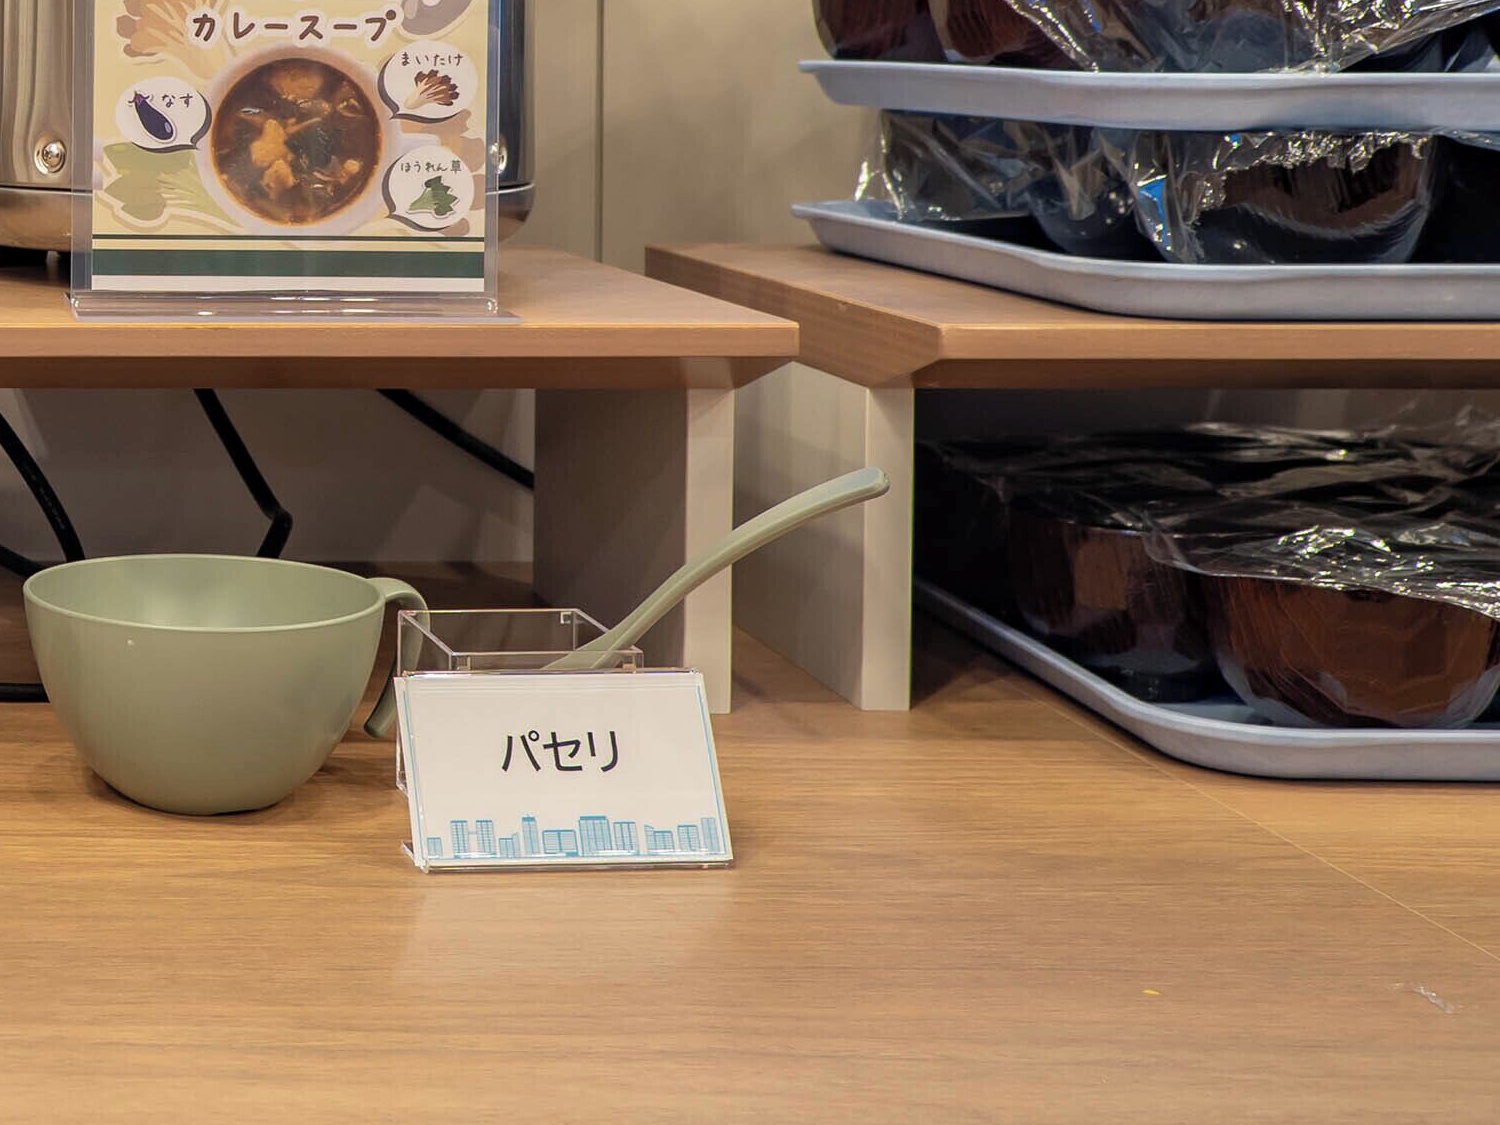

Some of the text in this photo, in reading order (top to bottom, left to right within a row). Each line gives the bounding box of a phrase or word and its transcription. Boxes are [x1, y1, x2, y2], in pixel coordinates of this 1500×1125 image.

[191, 9, 398, 42] カレースープ
[400, 51, 464, 68] まいたけ
[161, 92, 194, 108] なす
[399, 160, 463, 174] ほうれん草
[501, 729, 620, 773] パセリ
